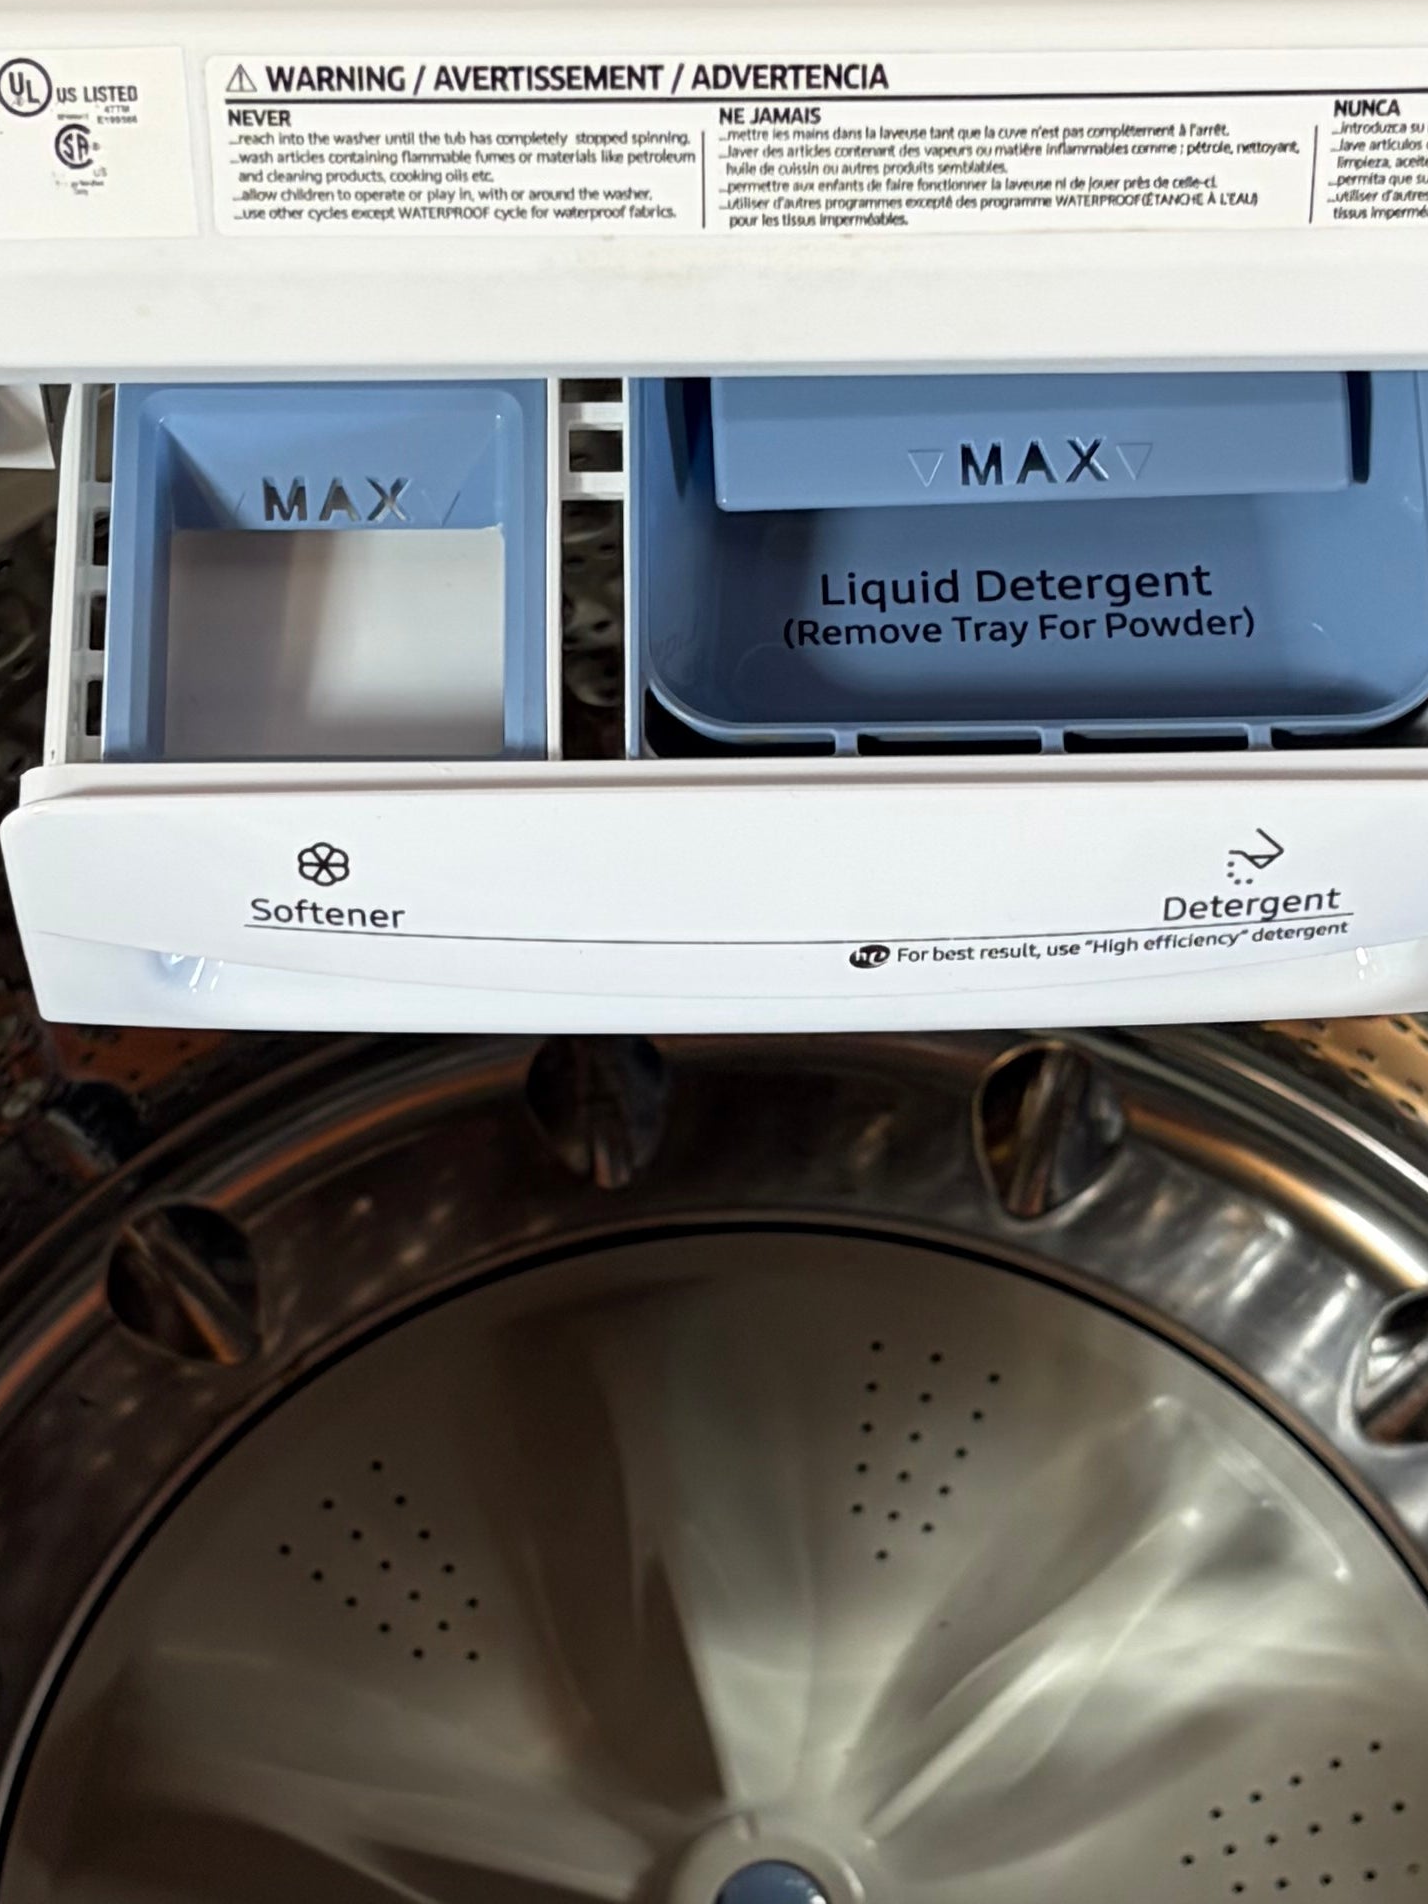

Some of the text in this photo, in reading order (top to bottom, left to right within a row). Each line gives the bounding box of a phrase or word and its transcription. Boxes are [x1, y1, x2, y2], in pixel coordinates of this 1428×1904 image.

[9, 72, 40, 103] UL
[56, 87, 77, 103] US
[84, 86, 138, 102] LISTED
[266, 61, 886, 95] WARNING / AVERTISSEMENT / ADVERTENCIA
[228, 110, 291, 126] NEVER
[719, 106, 821, 125] NE JAMAIS
[1333, 100, 1400, 117] NUNCA
[279, 132, 303, 145] into
[308, 132, 330, 145] the
[333, 132, 380, 145] washer
[384, 131, 414, 145] until
[419, 131, 440, 145] the
[444, 131, 466, 145] tub
[470, 132, 492, 145] has
[496, 131, 568, 147] completely
[575, 131, 627, 147] stopped
[632, 131, 691, 147] spinning.
[961, 437, 1108, 485] MAX
[263, 477, 410, 522] MAX
[821, 565, 1211, 612] Liquid Detergent
[783, 607, 1254, 649] (Remove Tray For Powder)
[251, 898, 404, 930] Softener
[1163, 888, 1340, 922] Detergent
[897, 947, 928, 962] For
[933, 945, 974, 962] best
[980, 944, 1041, 962] result,
[1047, 942, 1080, 958] use
[1252, 921, 1348, 946] detergent
